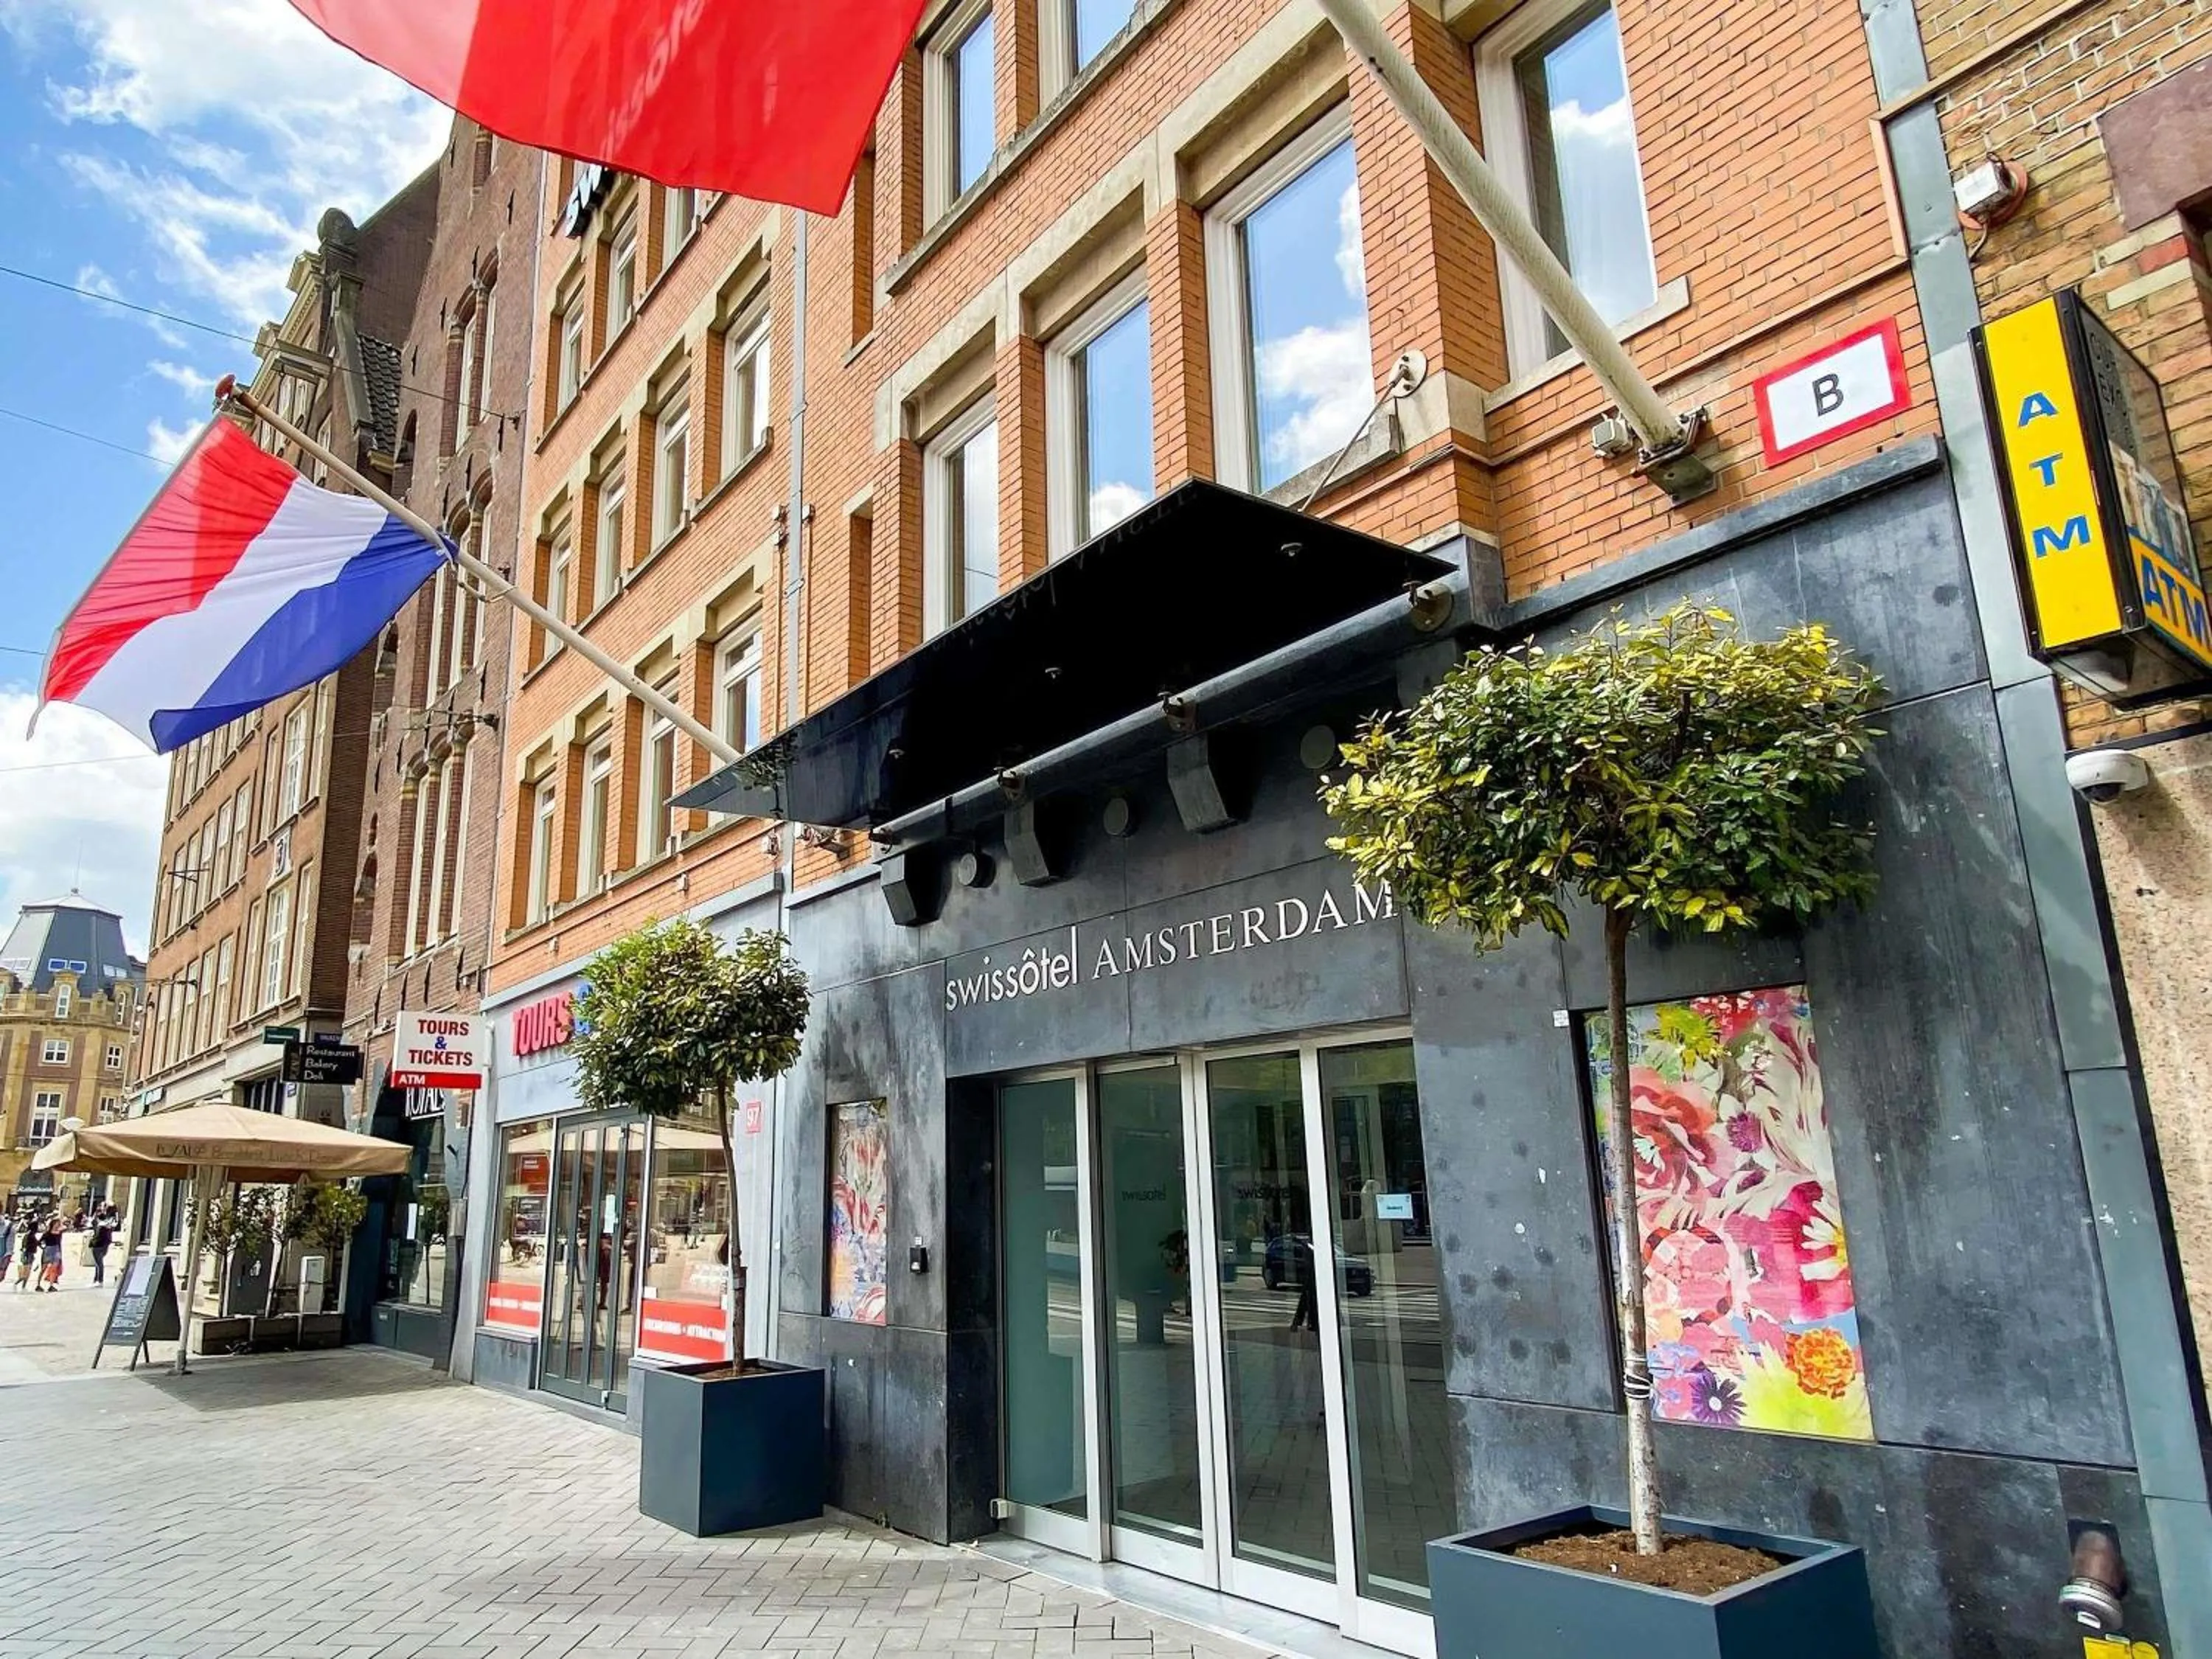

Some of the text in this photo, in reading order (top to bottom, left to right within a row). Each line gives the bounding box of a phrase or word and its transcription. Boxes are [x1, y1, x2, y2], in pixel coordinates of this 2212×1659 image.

[1812, 374, 1844, 417] B
[2017, 392, 2091, 558] ATM
[2140, 553, 2212, 652] ATM
[945, 880, 1398, 1012] swissôtel AMSTERDAM
[418, 1019, 470, 1036] TOURS
[512, 990, 572, 1057] TOURS
[306, 1045, 355, 1057] Restaurant
[435, 1037, 447, 1049] &
[305, 1058, 338, 1070] Bakery
[408, 1049, 473, 1066] TICKETS
[398, 1074, 425, 1085] ATM
